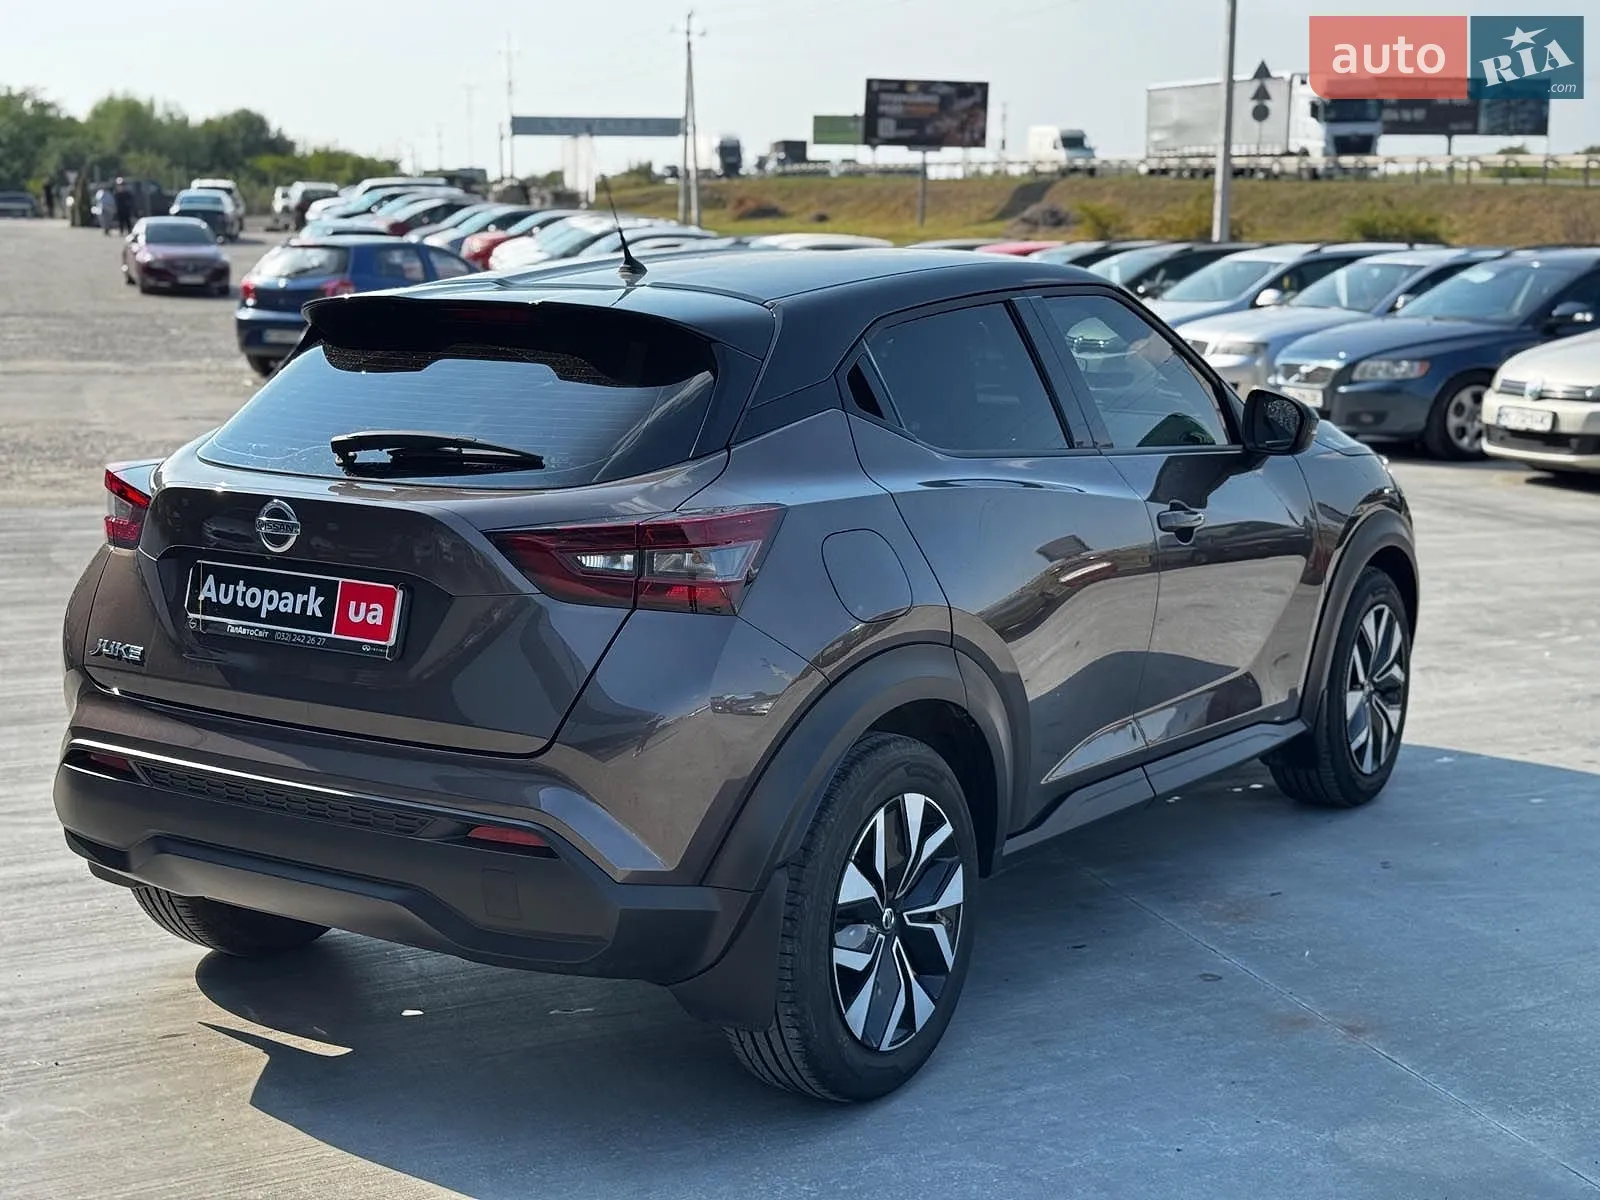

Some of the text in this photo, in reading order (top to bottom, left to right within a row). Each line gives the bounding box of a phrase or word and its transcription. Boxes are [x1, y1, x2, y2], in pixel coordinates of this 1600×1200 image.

[258, 519, 295, 533] NISSAN
[201, 573, 384, 626] Autopark ua
[292, 633, 306, 644] 242
[306, 636, 316, 645] 26
[316, 637, 327, 646] 27
[89, 638, 144, 662] JUKE
